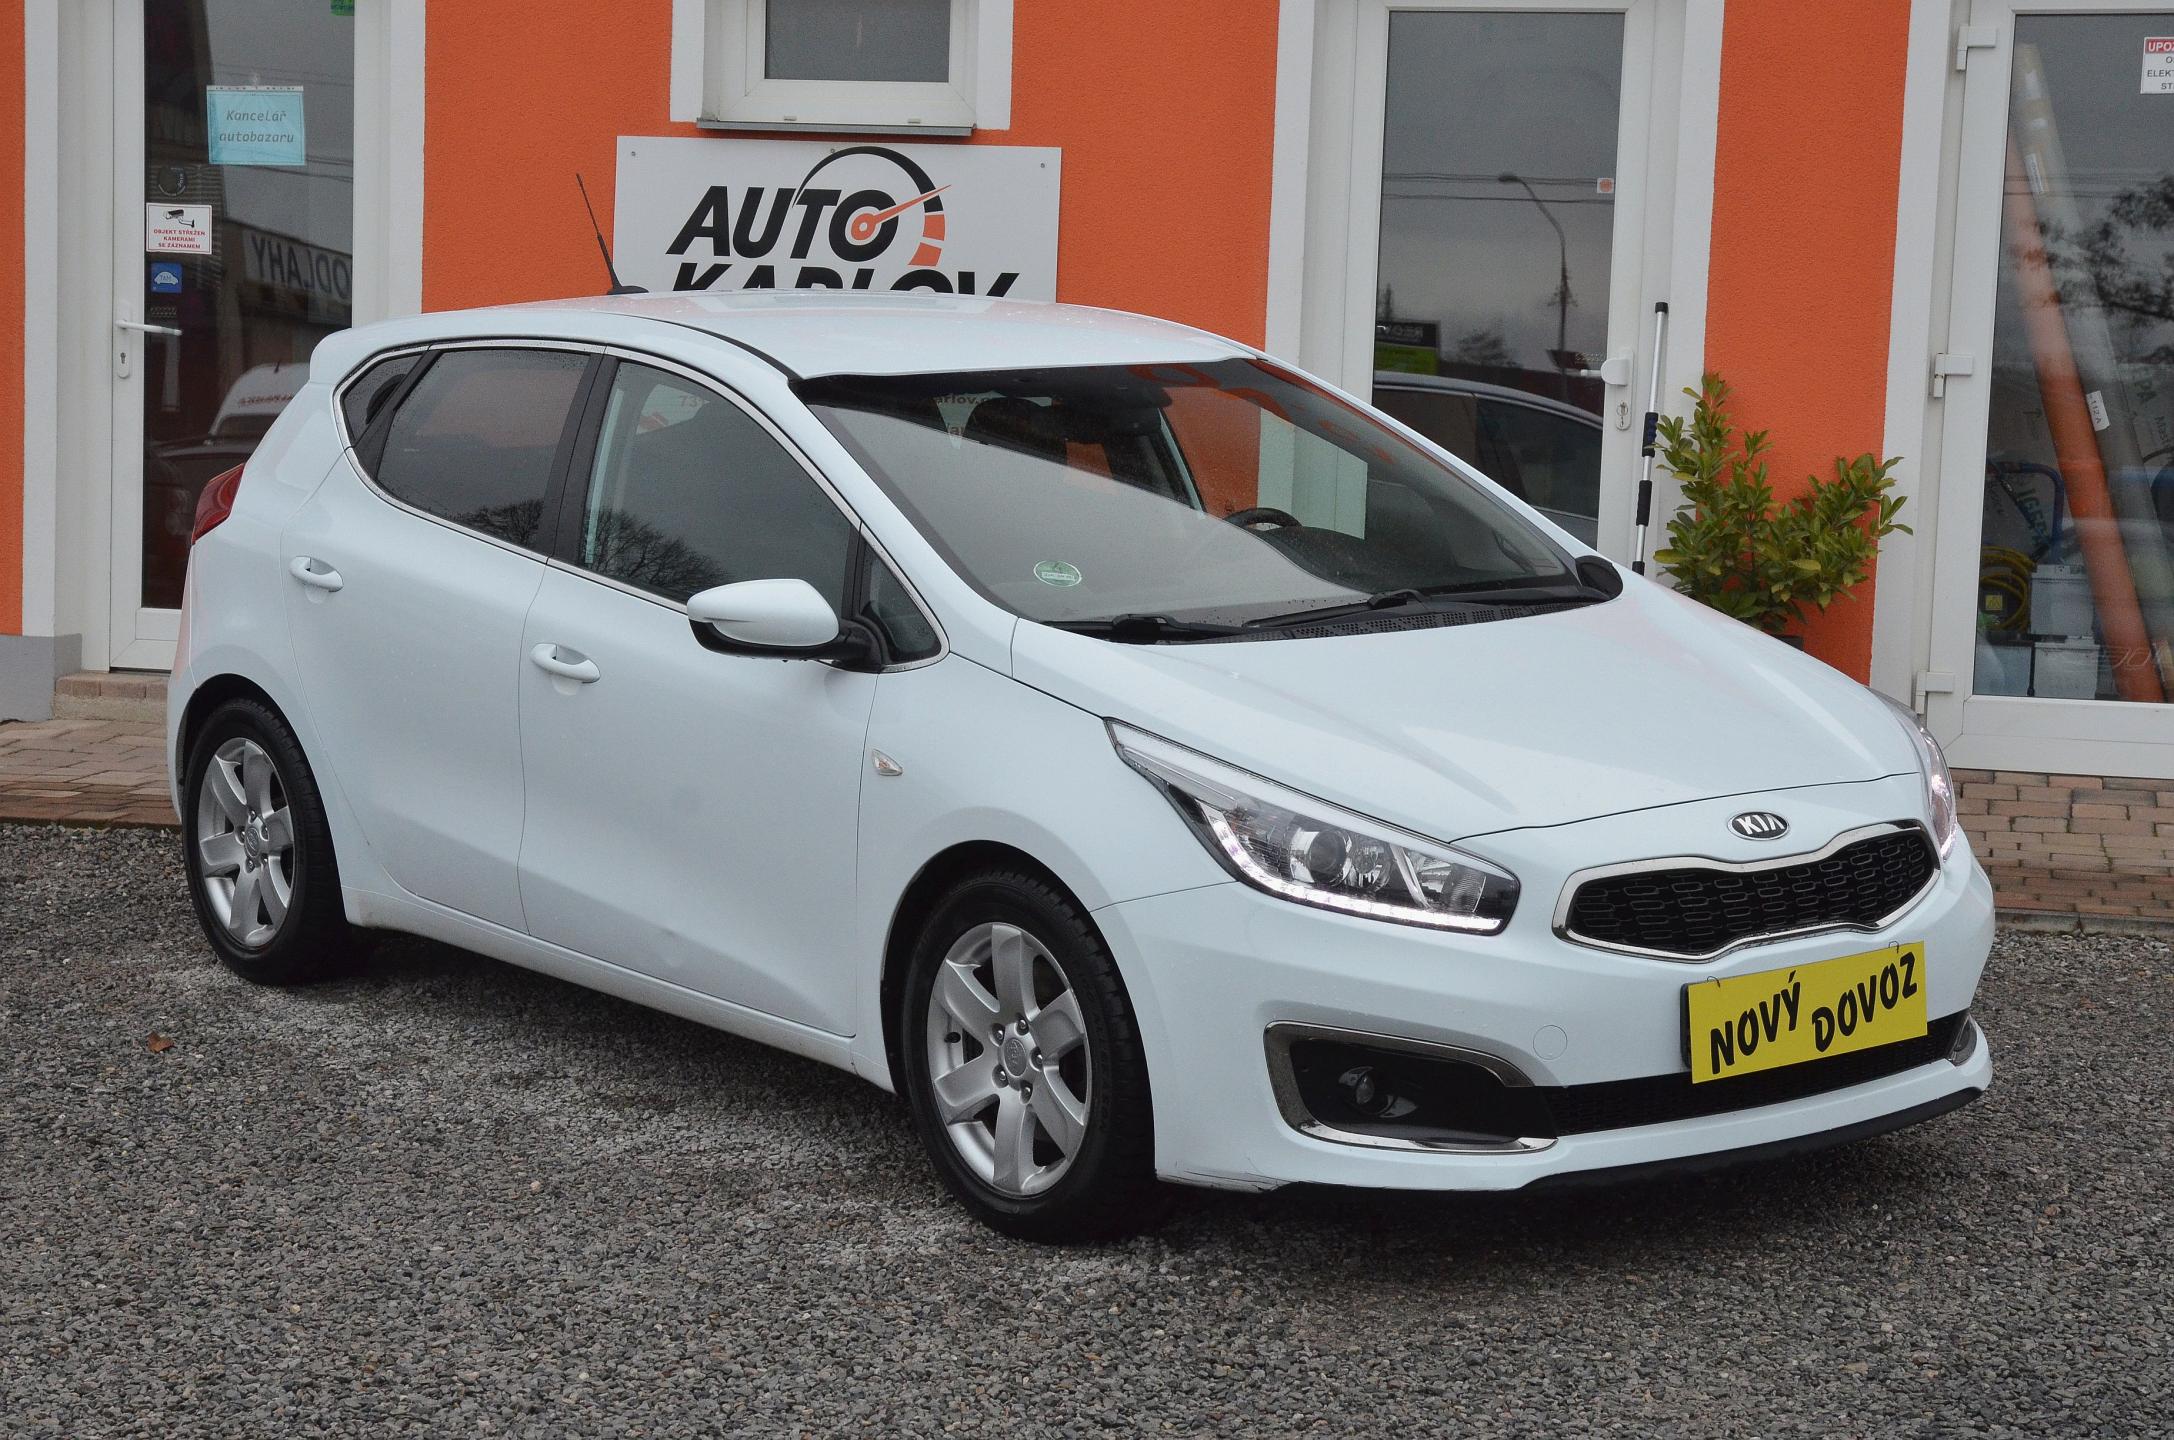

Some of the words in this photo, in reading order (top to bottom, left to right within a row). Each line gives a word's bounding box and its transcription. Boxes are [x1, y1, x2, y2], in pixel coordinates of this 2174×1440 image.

[226, 109, 287, 121] Kancelář
[219, 131, 295, 143] autobazaru
[665, 185, 899, 262] AUTO
[1736, 813, 1785, 835] KIA
[1710, 969, 1801, 1075] NOVÝ
[1811, 951, 1918, 1053] DOVOZ
